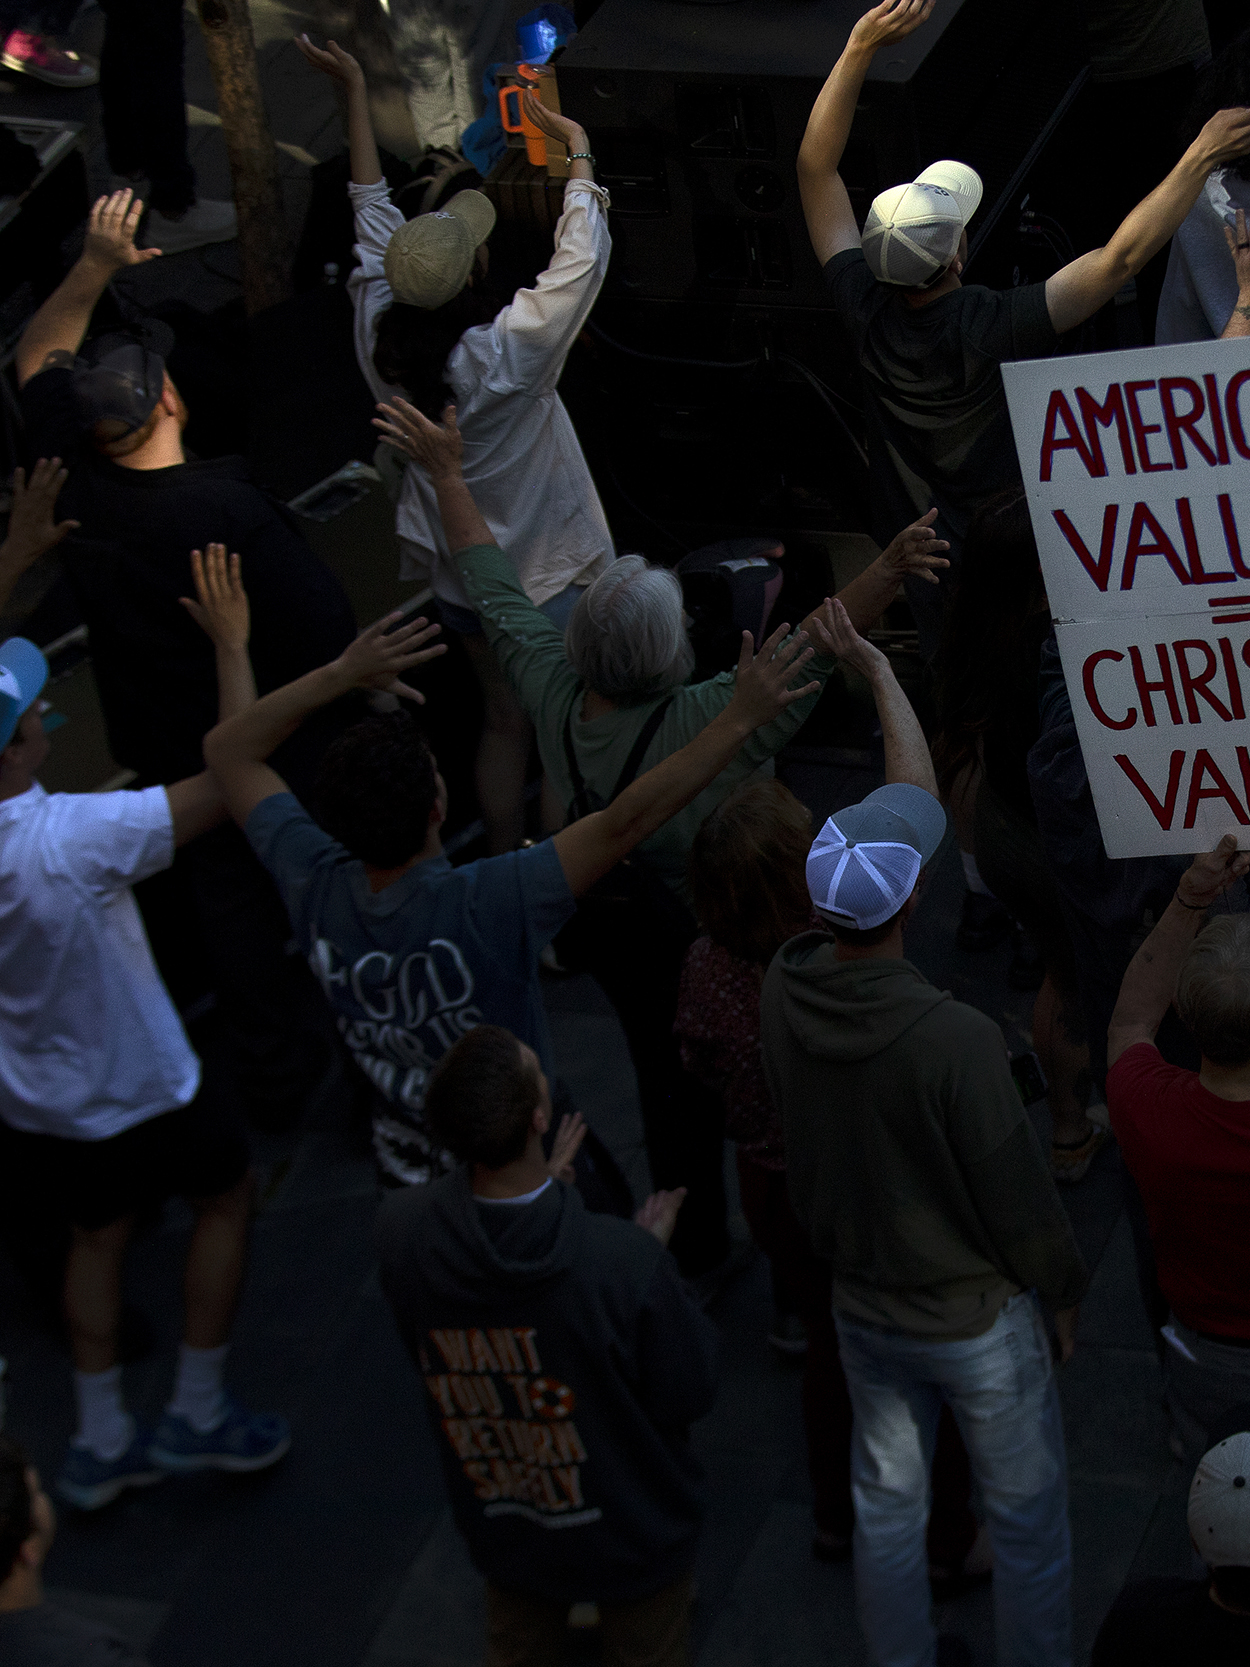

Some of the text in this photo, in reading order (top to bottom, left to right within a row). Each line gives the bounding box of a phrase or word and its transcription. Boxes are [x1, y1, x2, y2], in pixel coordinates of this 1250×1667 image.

[352, 938, 475, 1029] GOD
[428, 1327, 542, 1374] WANT
[425, 1373, 504, 1418] YOU
[441, 1419, 588, 1466] RETURN
